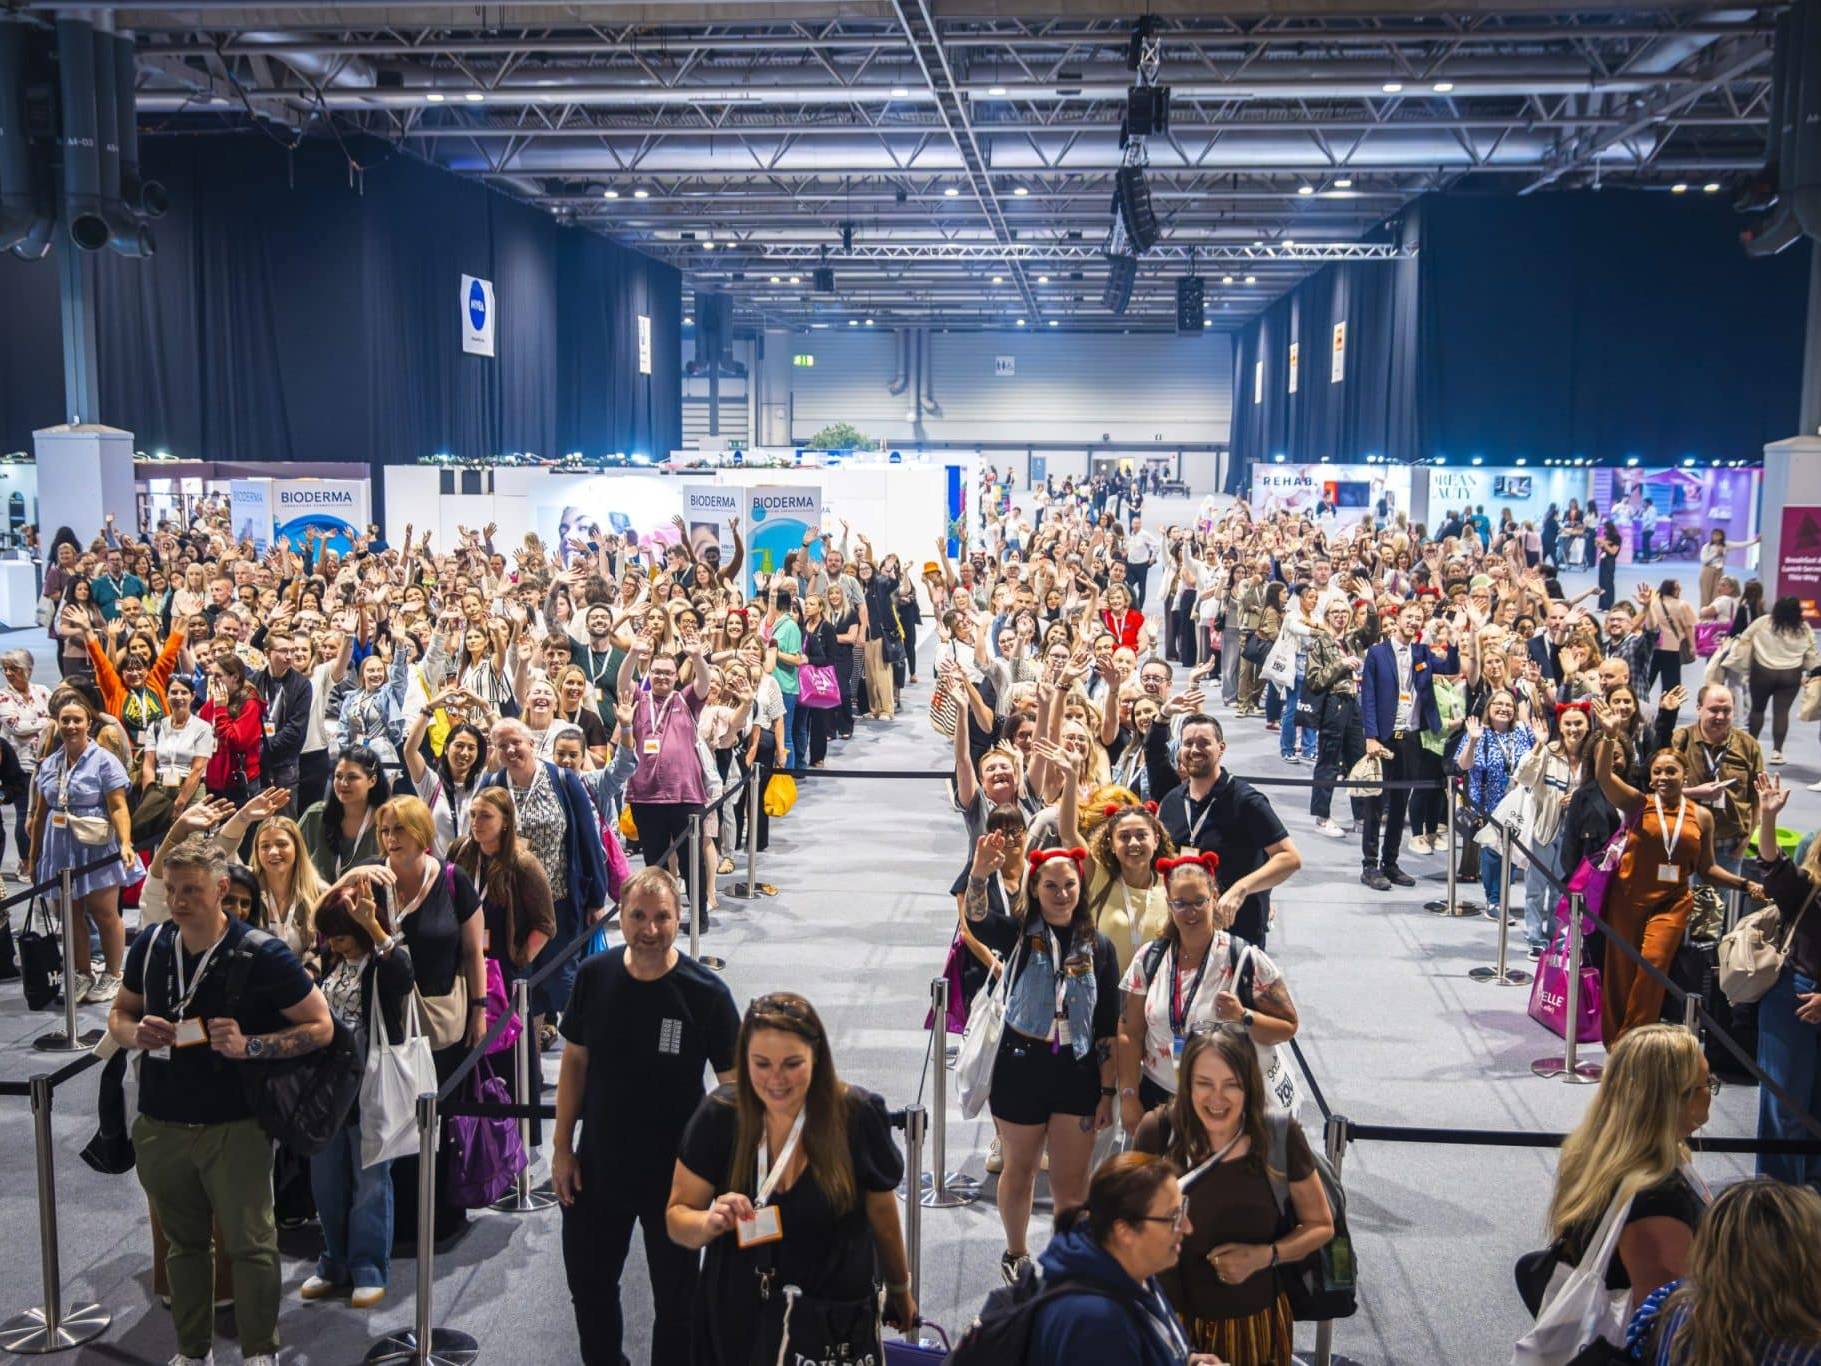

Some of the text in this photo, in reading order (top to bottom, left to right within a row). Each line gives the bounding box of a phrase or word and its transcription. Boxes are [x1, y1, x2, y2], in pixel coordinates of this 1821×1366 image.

[281, 491, 352, 502] BIODERMA
[690, 494, 736, 507] BIODERMA
[753, 496, 814, 508] BIODERMA
